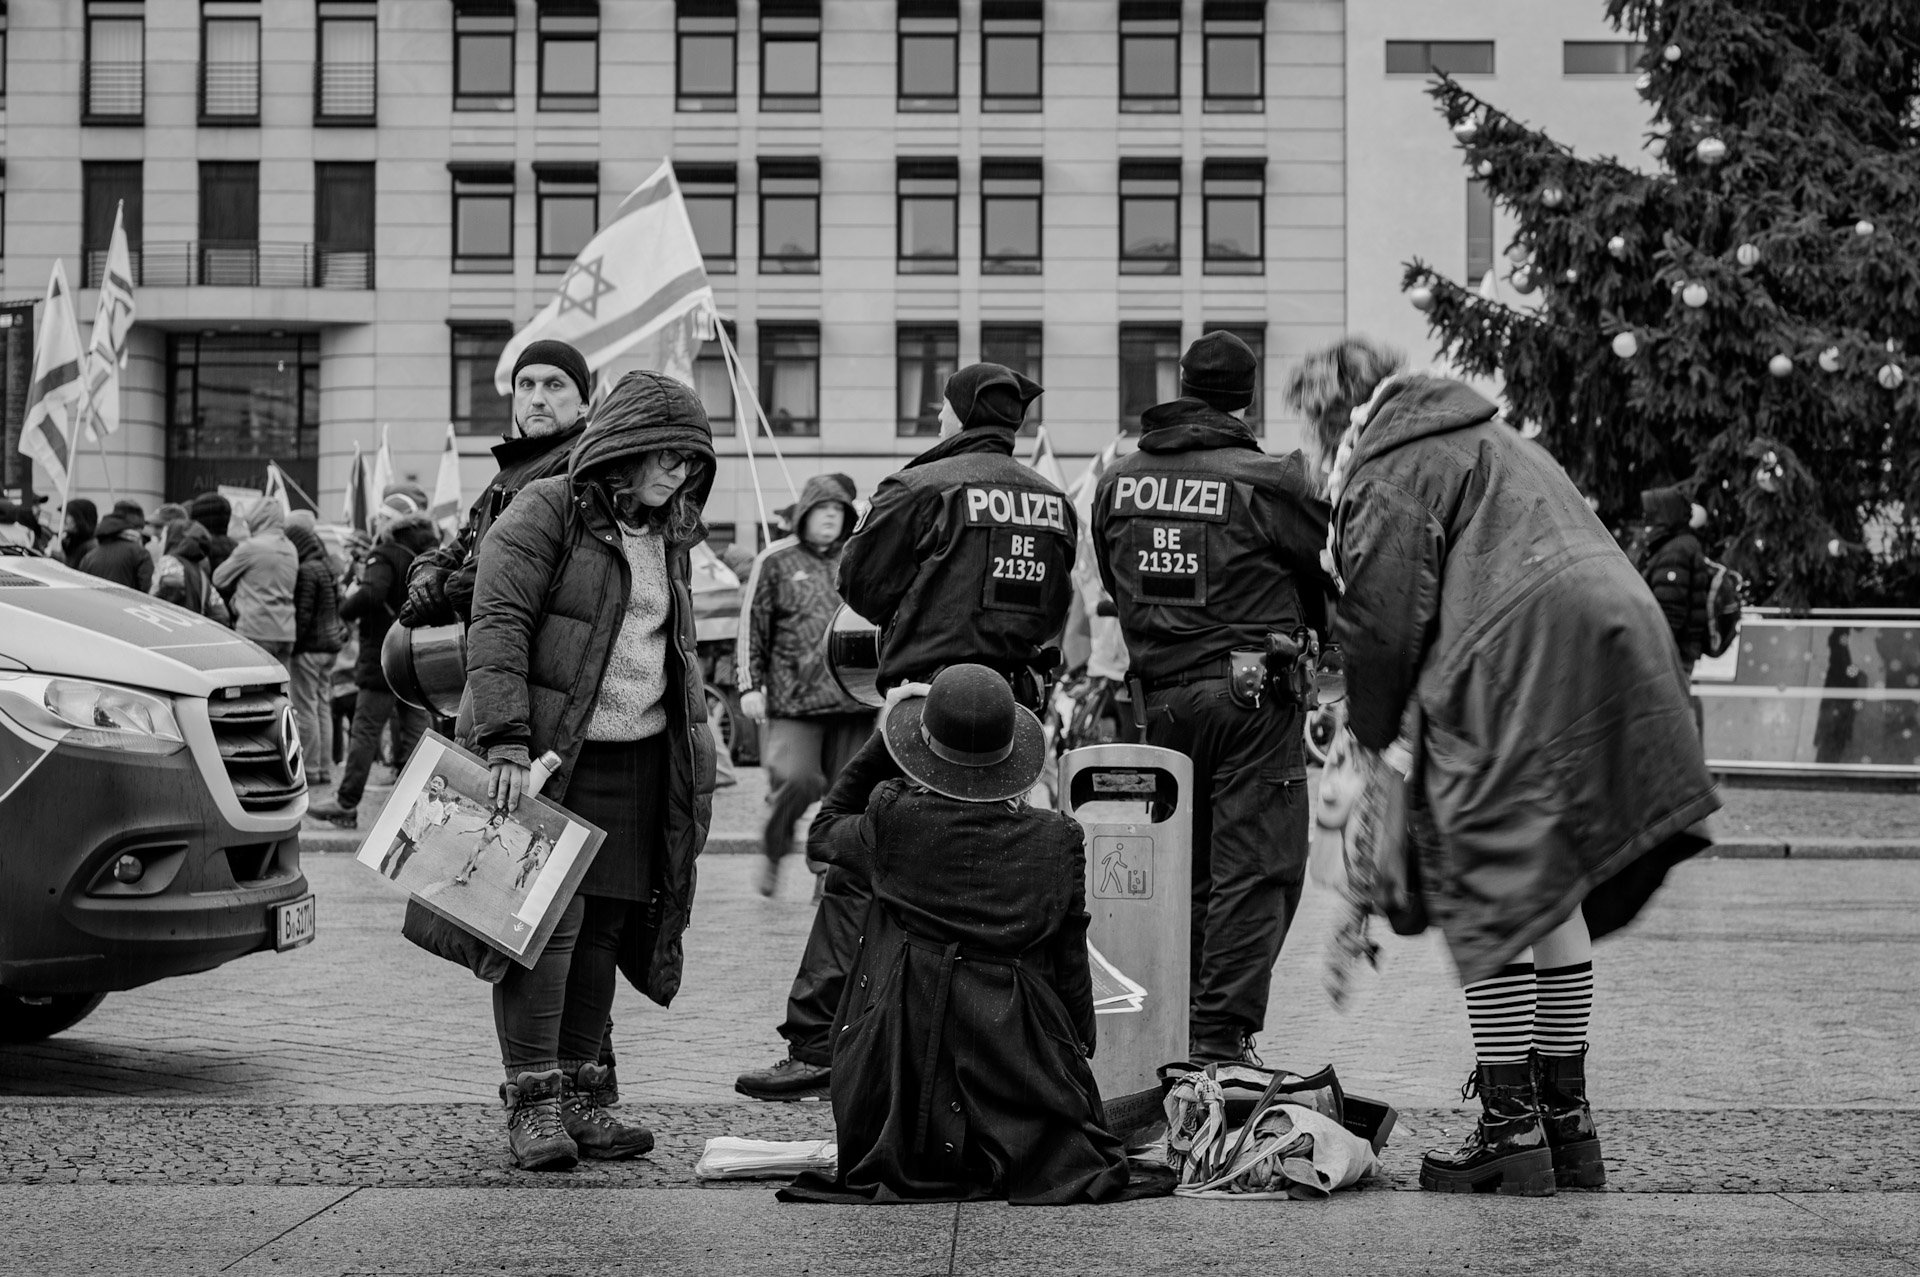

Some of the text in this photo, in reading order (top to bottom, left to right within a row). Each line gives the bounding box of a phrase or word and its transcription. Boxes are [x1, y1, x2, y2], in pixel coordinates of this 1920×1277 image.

[1114, 476, 1227, 515] POLIZEI
[966, 488, 1064, 530] POLIZEI
[1011, 534, 1035, 557] BE
[1153, 527, 1181, 550] BE
[992, 557, 1046, 582] 21329
[1138, 550, 1199, 574] 21325
